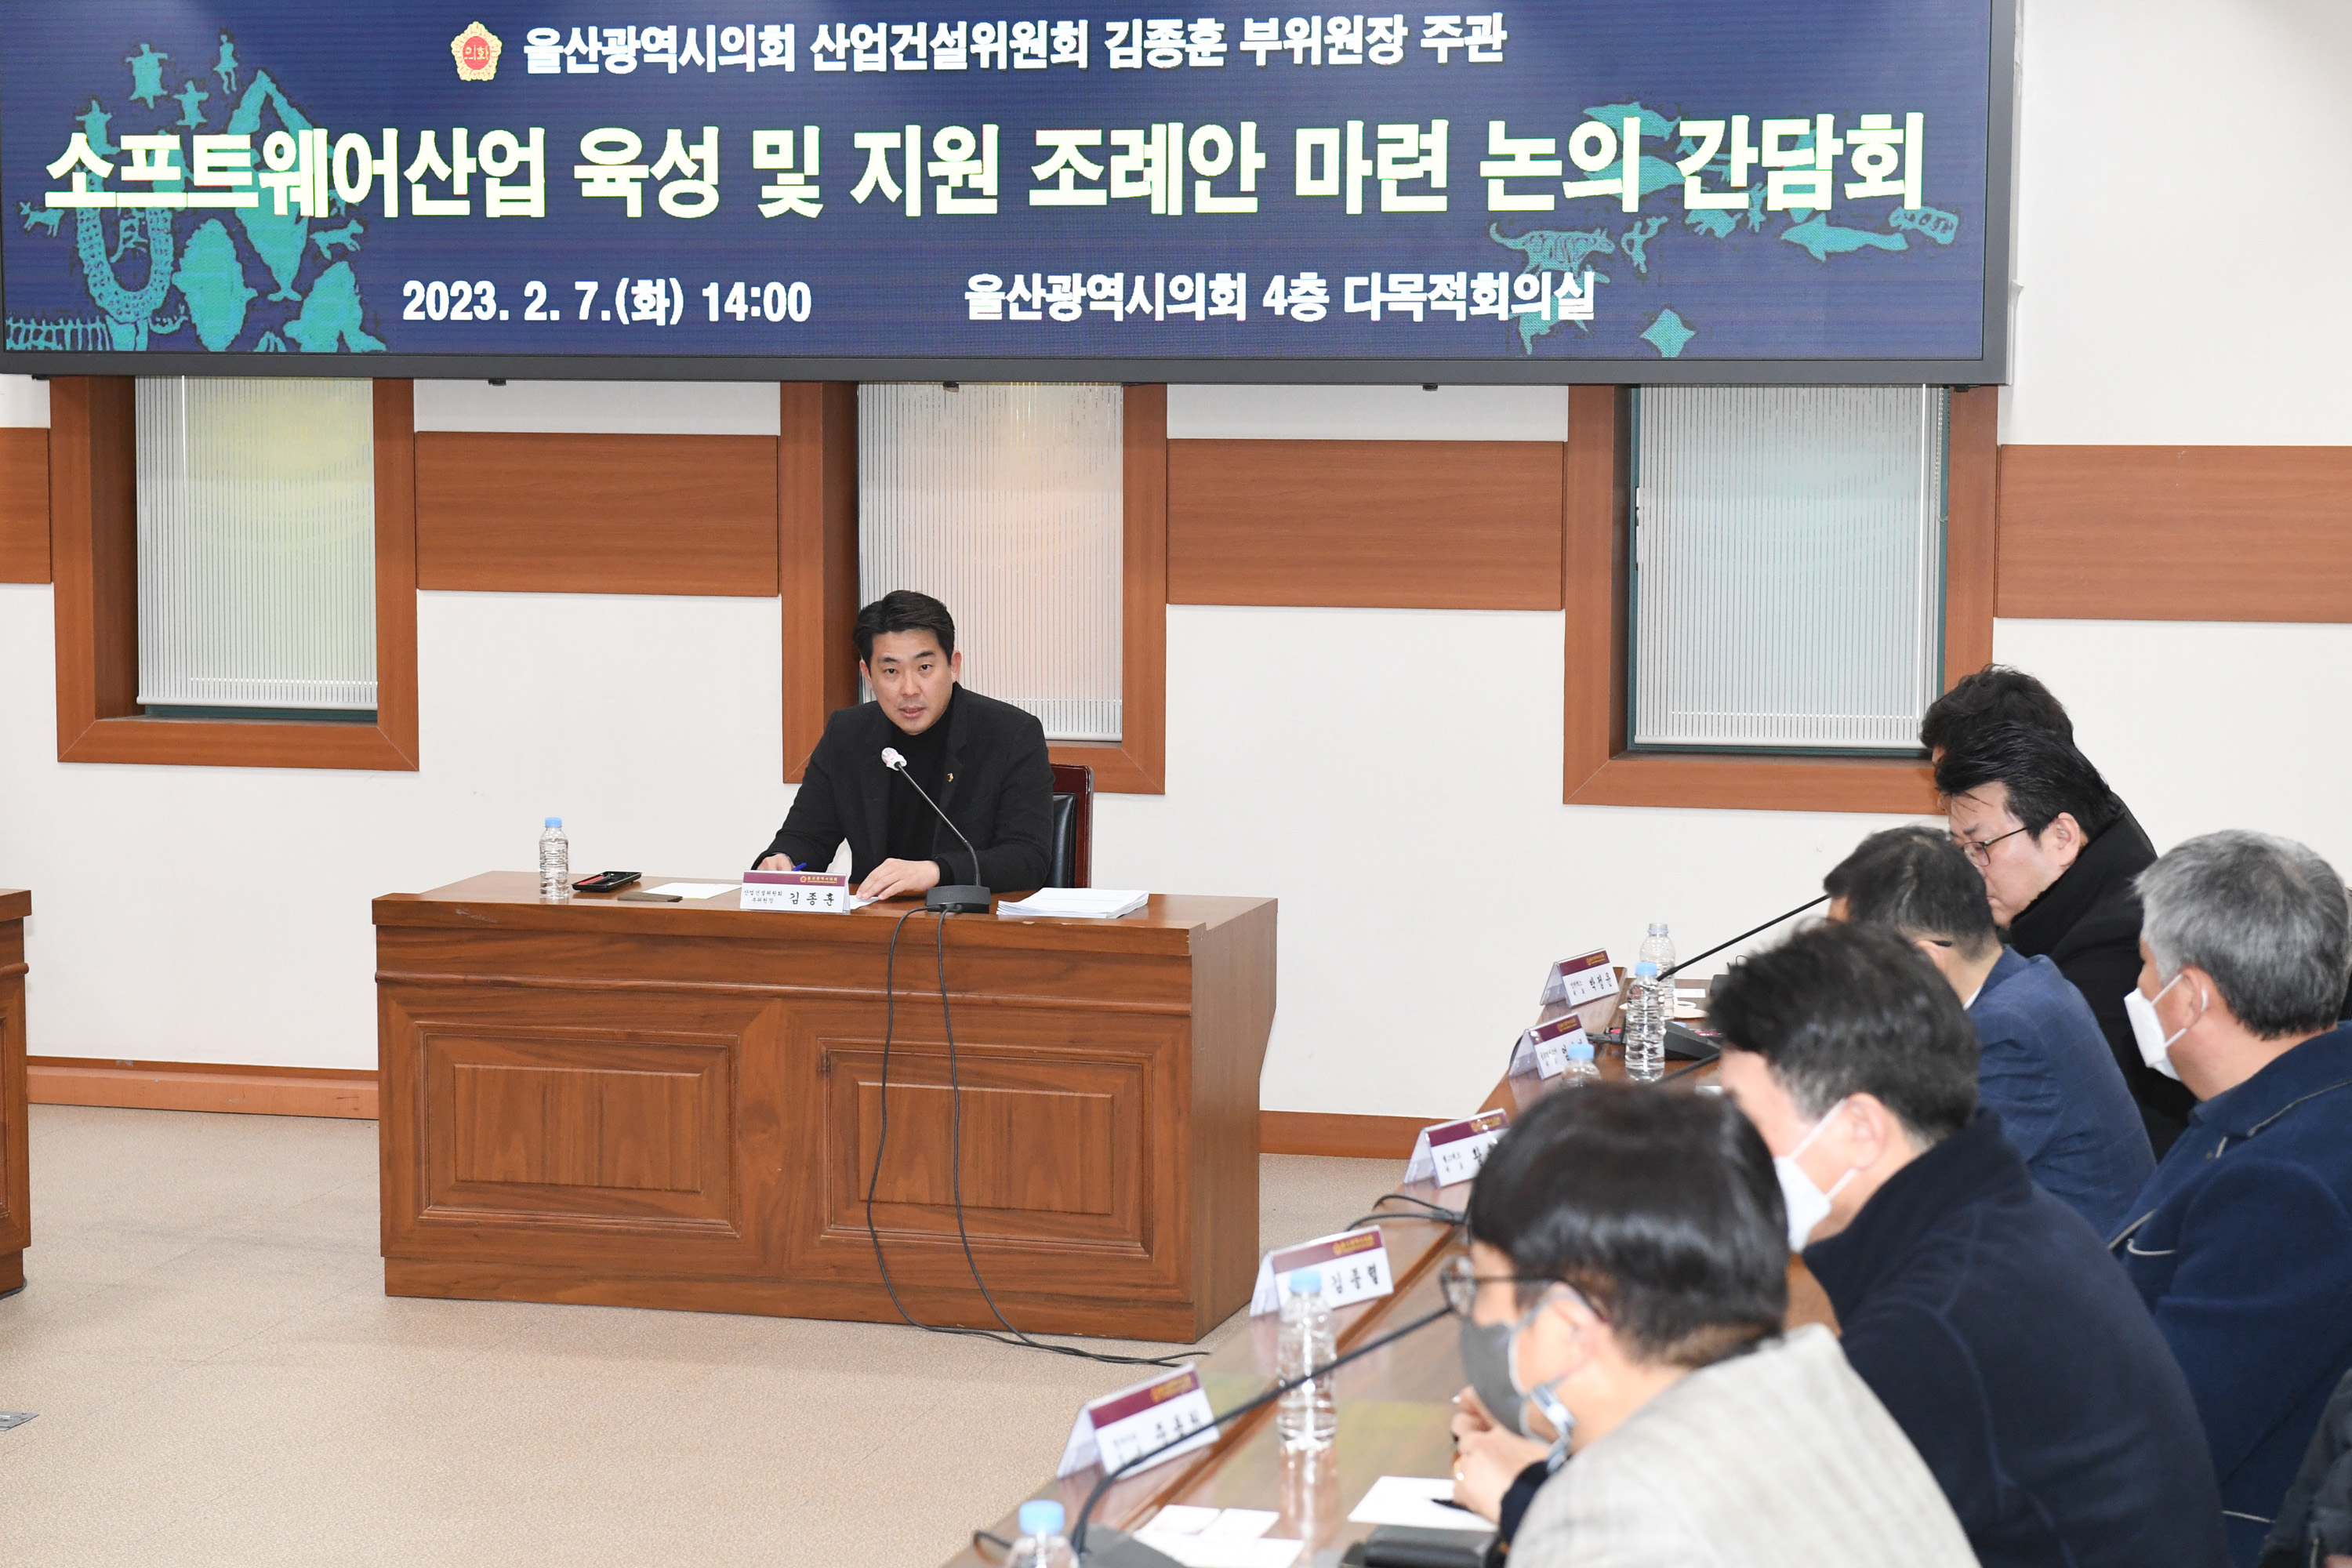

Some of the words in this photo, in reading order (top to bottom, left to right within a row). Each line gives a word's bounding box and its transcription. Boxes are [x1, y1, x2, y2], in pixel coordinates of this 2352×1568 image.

[524, 24, 794, 74] 울산광역시의회
[811, 20, 1087, 71] 산업건설위원회
[1105, 19, 1227, 68] 김종훈
[1240, 15, 1408, 66] 부위원장
[1421, 13, 1507, 63] 주관
[45, 128, 544, 217] 소프트웨어산업
[575, 127, 718, 218] 육성
[753, 126, 822, 217] 및
[851, 125, 998, 216] 지원
[1029, 122, 1265, 215] 조례안
[1296, 120, 1448, 214] 마련
[1480, 117, 1640, 212] 논의
[1676, 113, 1923, 210] 간담회
[404, 281, 508, 320] 2023.
[524, 281, 559, 320] 2.
[575, 278, 683, 325] 7.(화)
[702, 282, 811, 321] 14:00
[965, 273, 1246, 321] 울산광역시의회
[1263, 273, 1329, 321] 4층
[1345, 271, 1595, 321] 다목적회의실
[789, 891, 834, 906] 김종훈
